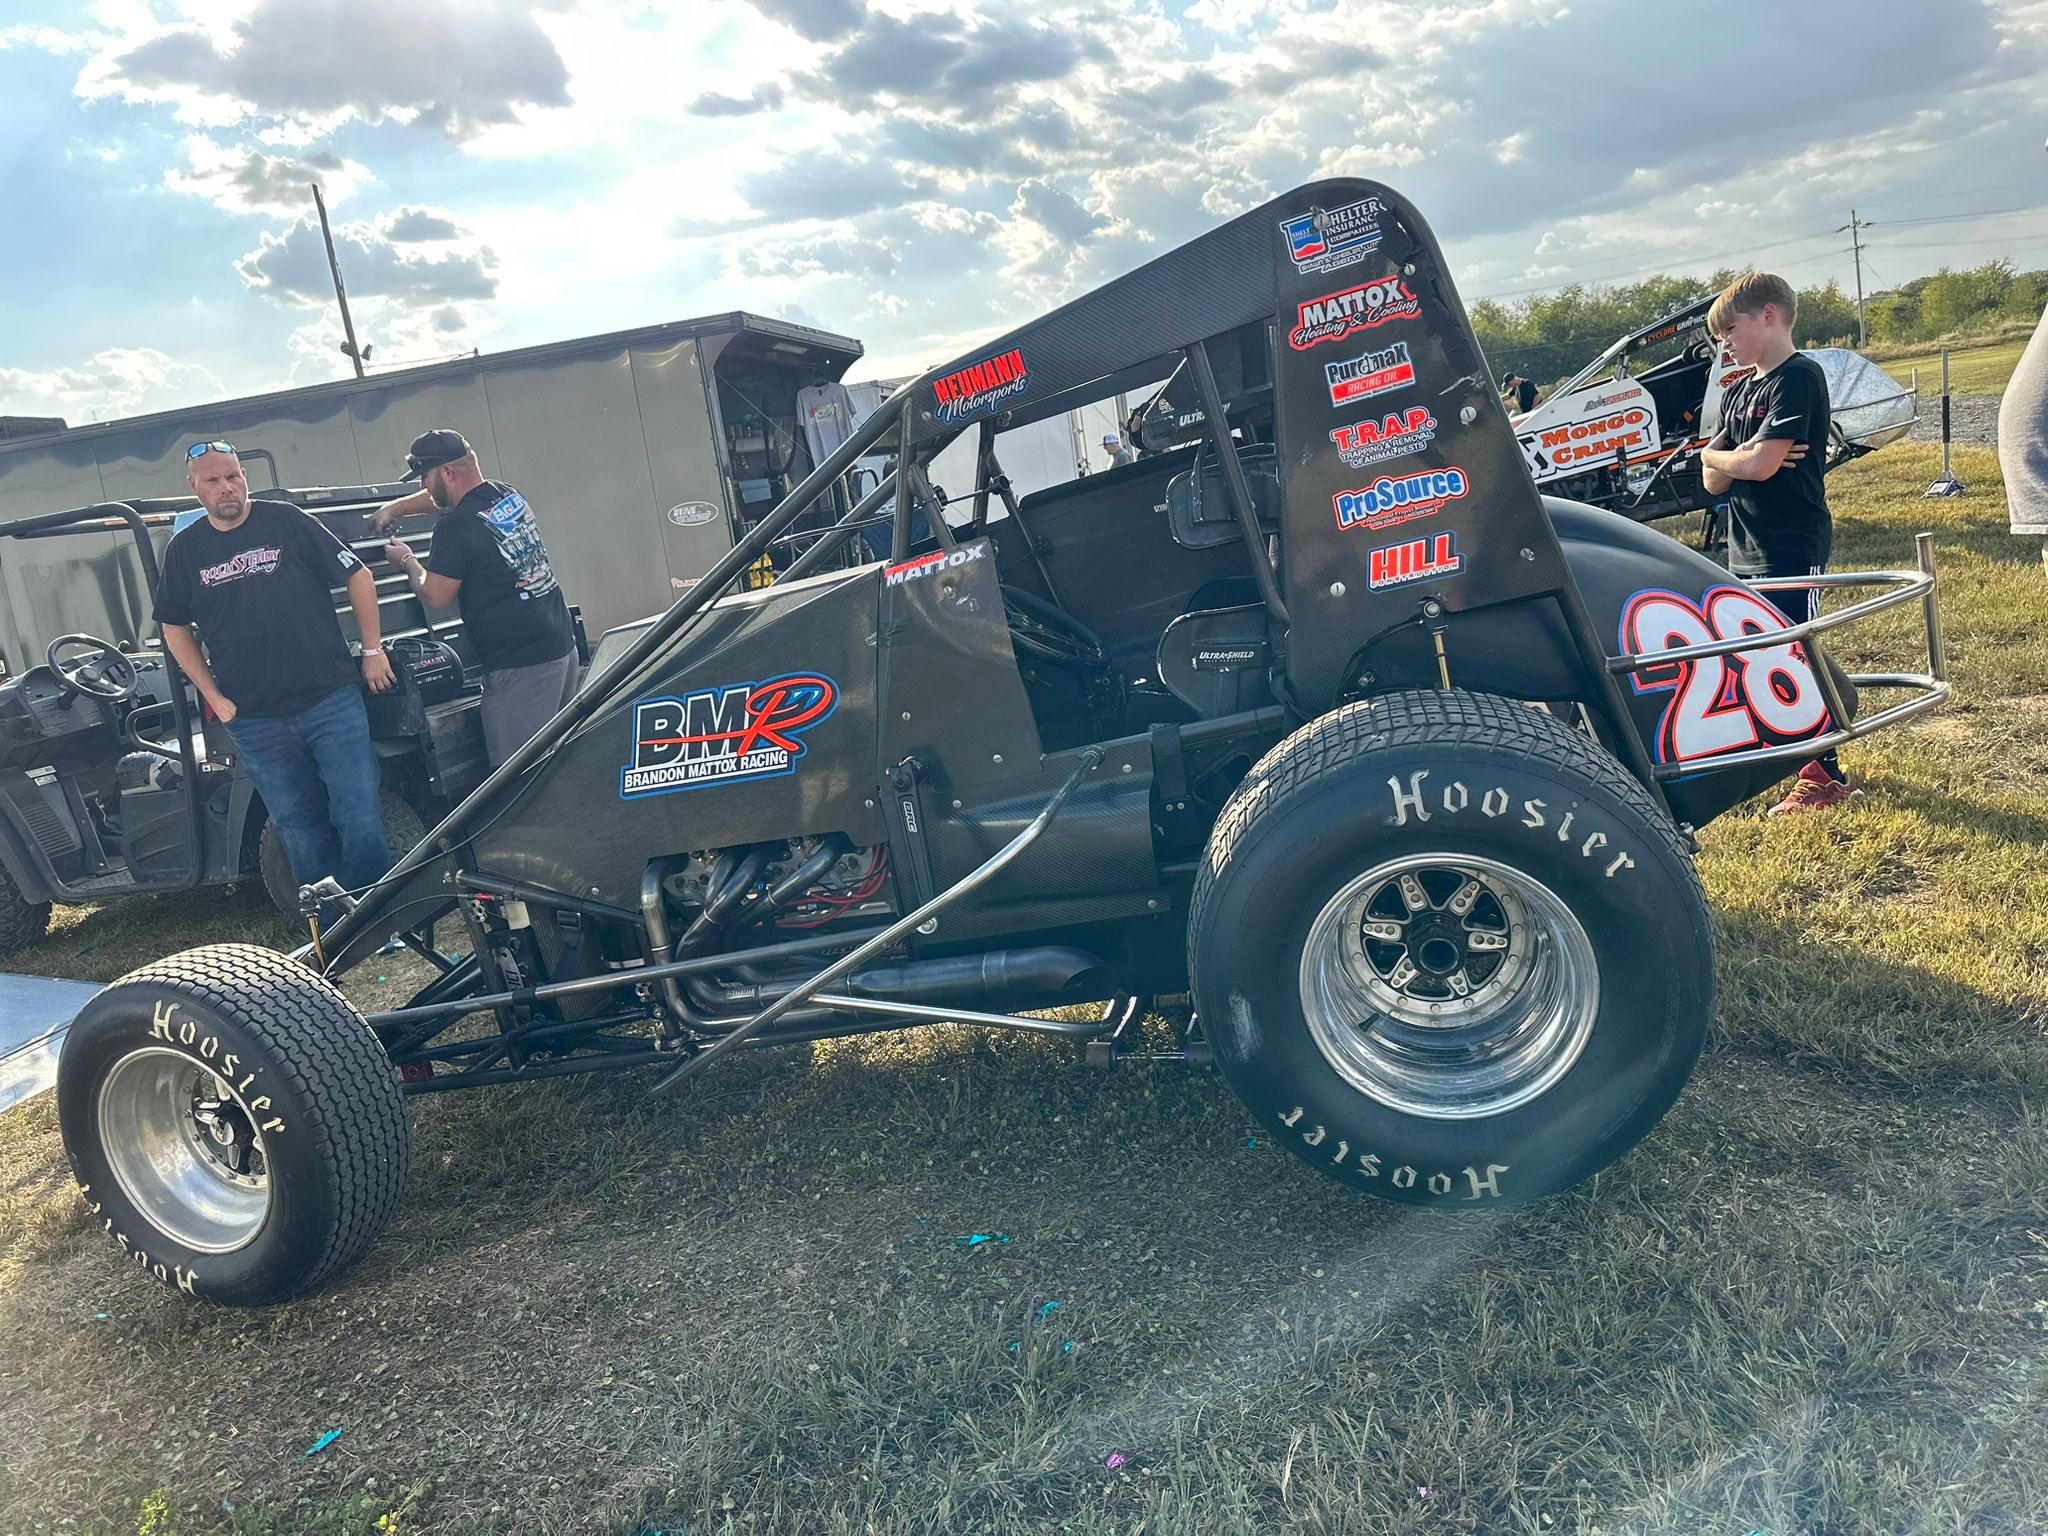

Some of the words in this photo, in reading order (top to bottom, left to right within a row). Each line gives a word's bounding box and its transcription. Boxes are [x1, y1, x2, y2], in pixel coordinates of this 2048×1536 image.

[1324, 201, 1379, 227] HELTER
[1330, 222, 1380, 243] COMPANIES
[1325, 253, 1362, 270] AGENT
[1294, 321, 1346, 345] Heating
[1350, 313, 1362, 327] &
[1367, 299, 1418, 322] Cooling
[1303, 279, 1403, 329] MATTOX
[933, 348, 1028, 405] NEUMANN
[937, 373, 1026, 421] Motorsports
[1347, 375, 1382, 394] RACING
[1383, 370, 1399, 384] OIL
[1332, 408, 1435, 452] T.R.A.P.
[1342, 443, 1384, 460] TRAPPING
[1392, 431, 1433, 447] REMOVAL
[1541, 411, 1644, 449] MONGO
[1552, 431, 1642, 464] CRANE
[1352, 457, 1363, 467] OF
[1364, 450, 1396, 464] ANIMAL
[1397, 442, 1425, 455] PESTS
[1337, 471, 1463, 525] ProSource
[245, 562, 277, 574] Racing
[886, 542, 988, 587] MATTOX
[1370, 563, 1459, 588] CONSTRUCTION
[1371, 534, 1459, 582] HILL
[1620, 587, 1829, 763] 28
[635, 677, 832, 770] BMR
[624, 764, 686, 789] BRANDON
[688, 757, 737, 778] MATTOX
[740, 749, 788, 770] RACING
[1383, 769, 1636, 878] Hoosier
[148, 999, 286, 1133] Hoosier
[1277, 1106, 1510, 1201] Hoosier
